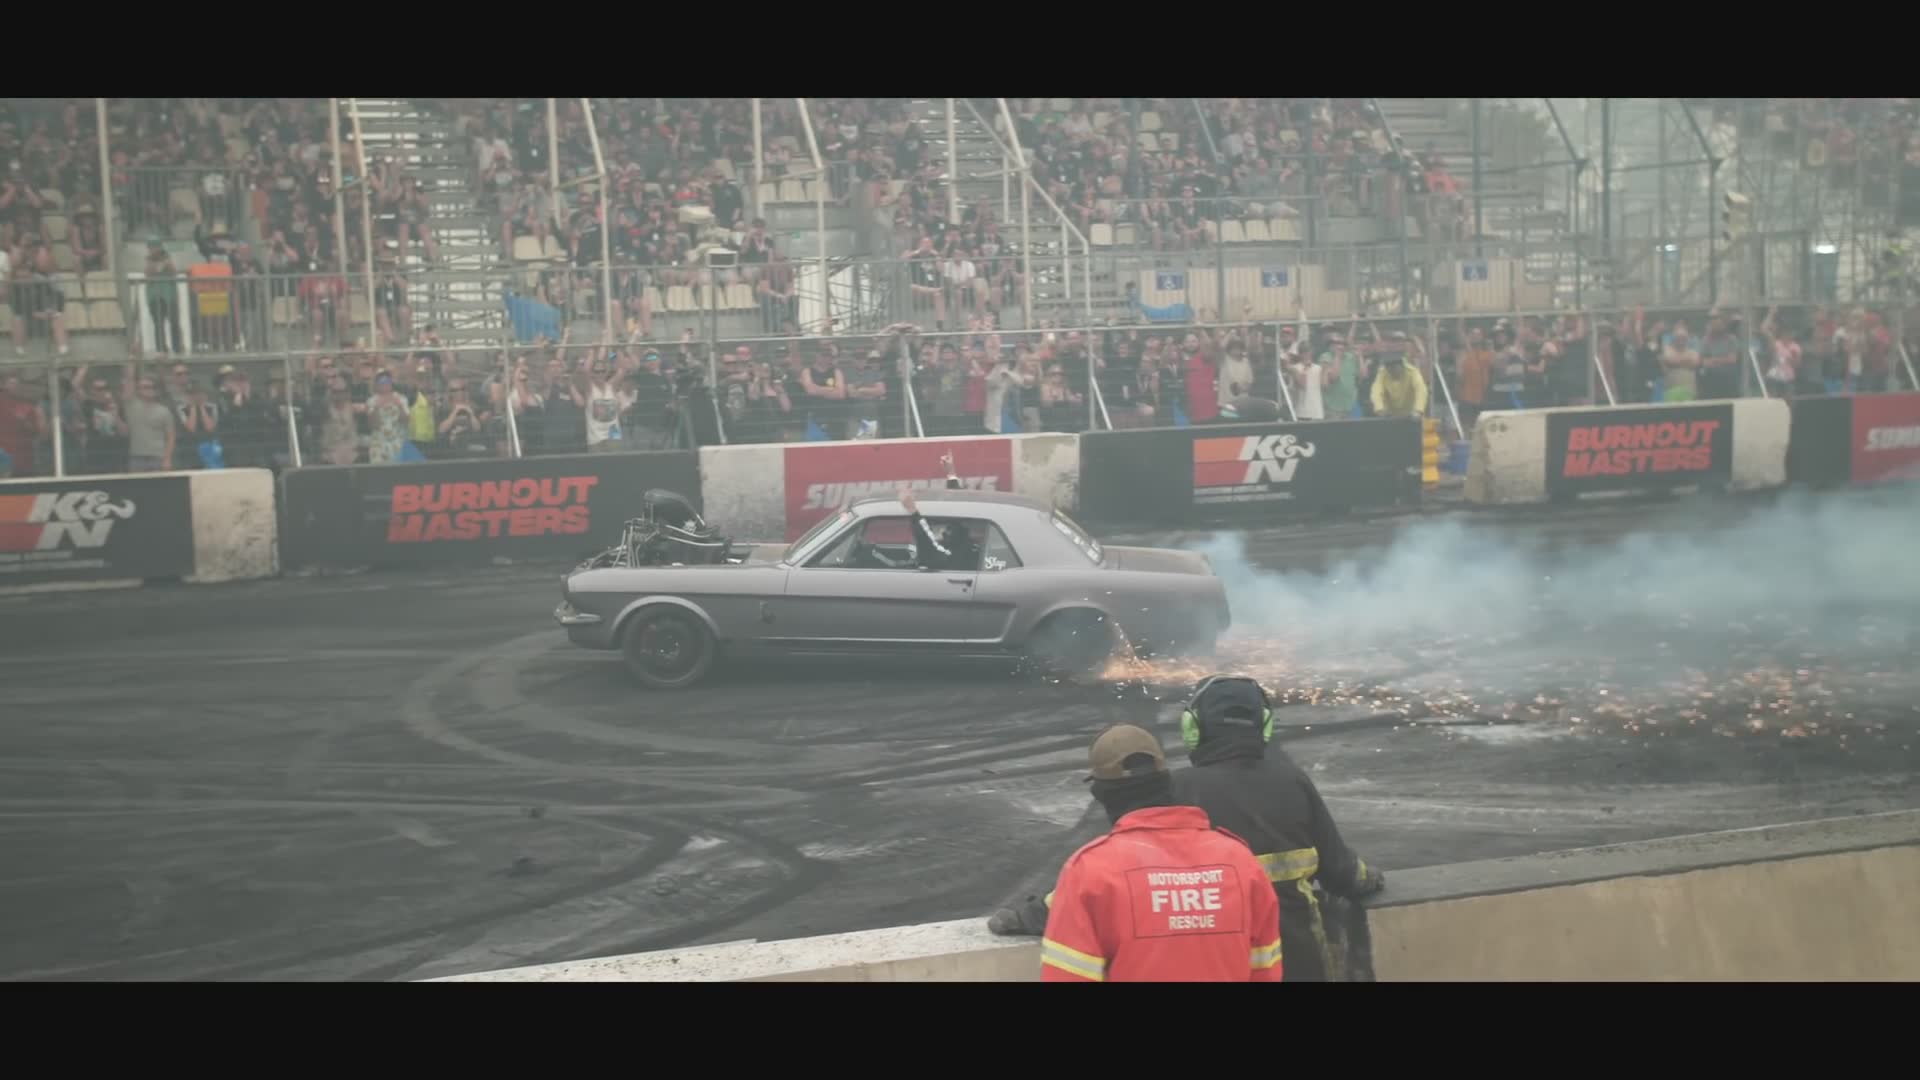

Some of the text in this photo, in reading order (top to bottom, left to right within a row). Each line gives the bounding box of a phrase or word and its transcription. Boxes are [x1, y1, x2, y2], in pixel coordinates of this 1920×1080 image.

[1567, 420, 1720, 452] BURNOUT
[1563, 446, 1712, 478] MASTERS
[392, 476, 598, 513] BURNOUT
[387, 505, 588, 542] MASTERS
[1147, 869, 1223, 887] MOTORSPORT
[1151, 887, 1222, 912] FIRE
[1168, 914, 1215, 930] RESCUE
